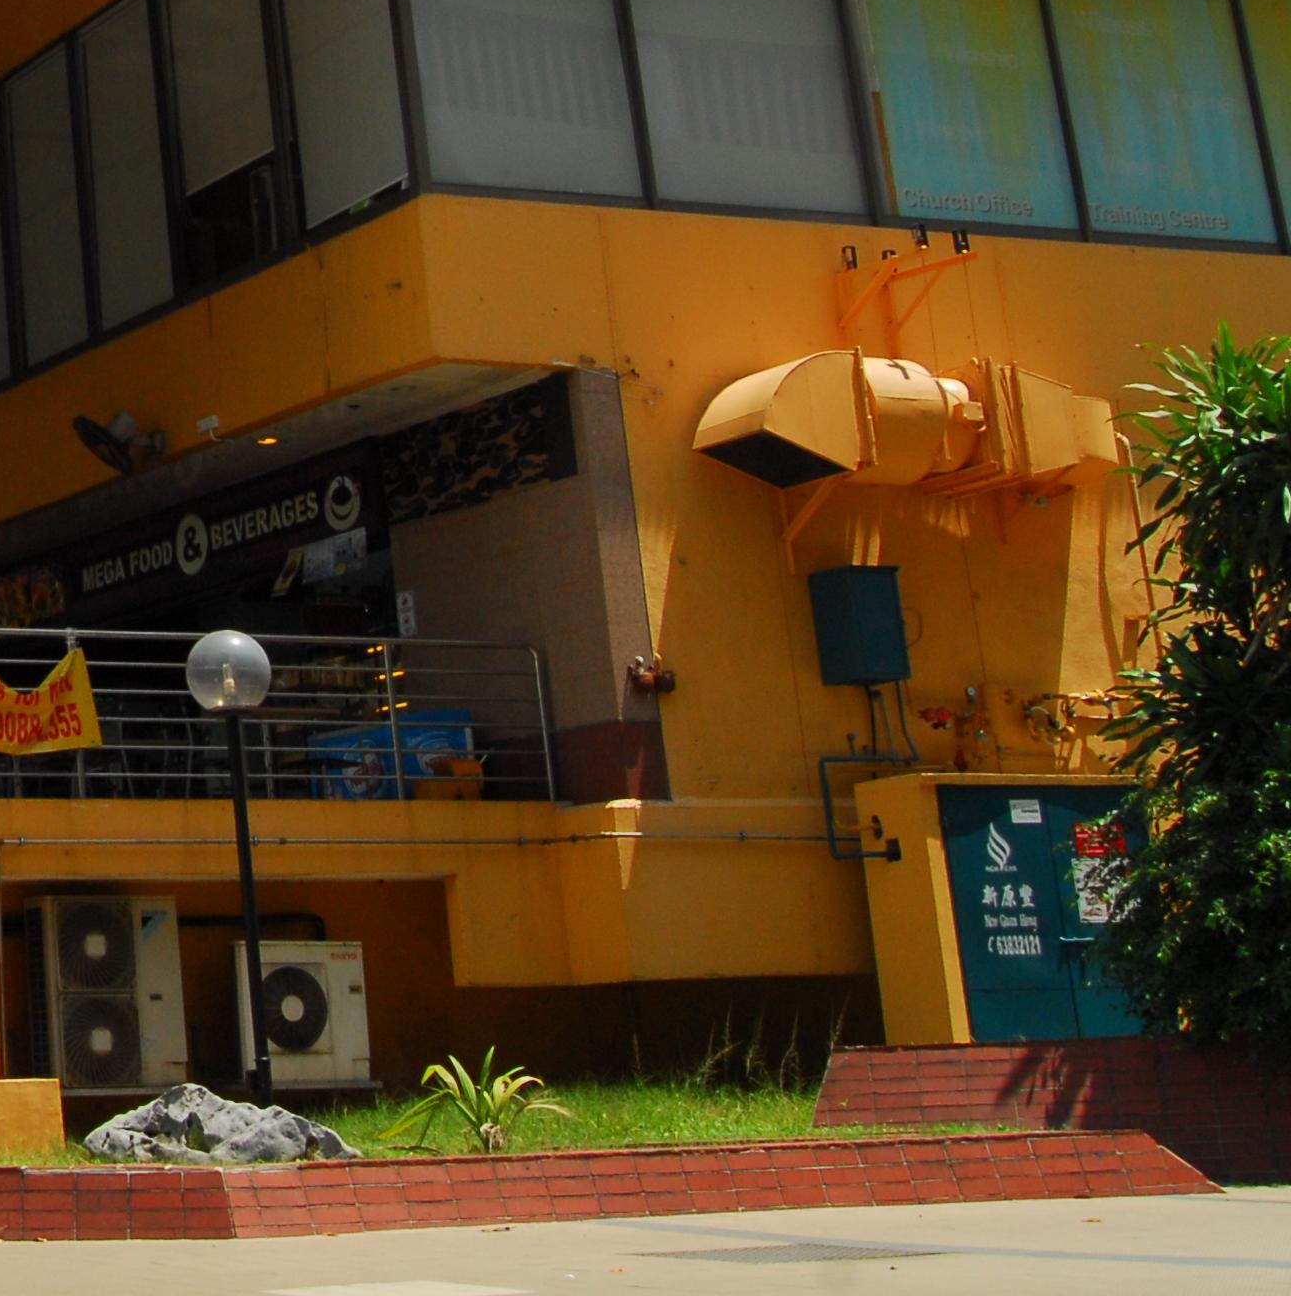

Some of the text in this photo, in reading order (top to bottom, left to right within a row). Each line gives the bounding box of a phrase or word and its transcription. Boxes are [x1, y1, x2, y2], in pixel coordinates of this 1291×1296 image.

[903, 189, 1035, 219] Church Office
[1091, 204, 1230, 231] Training Centre
[81, 555, 126, 593] MEGA
[129, 540, 174, 577] FOOD
[210, 489, 319, 552] BEVERAGES
